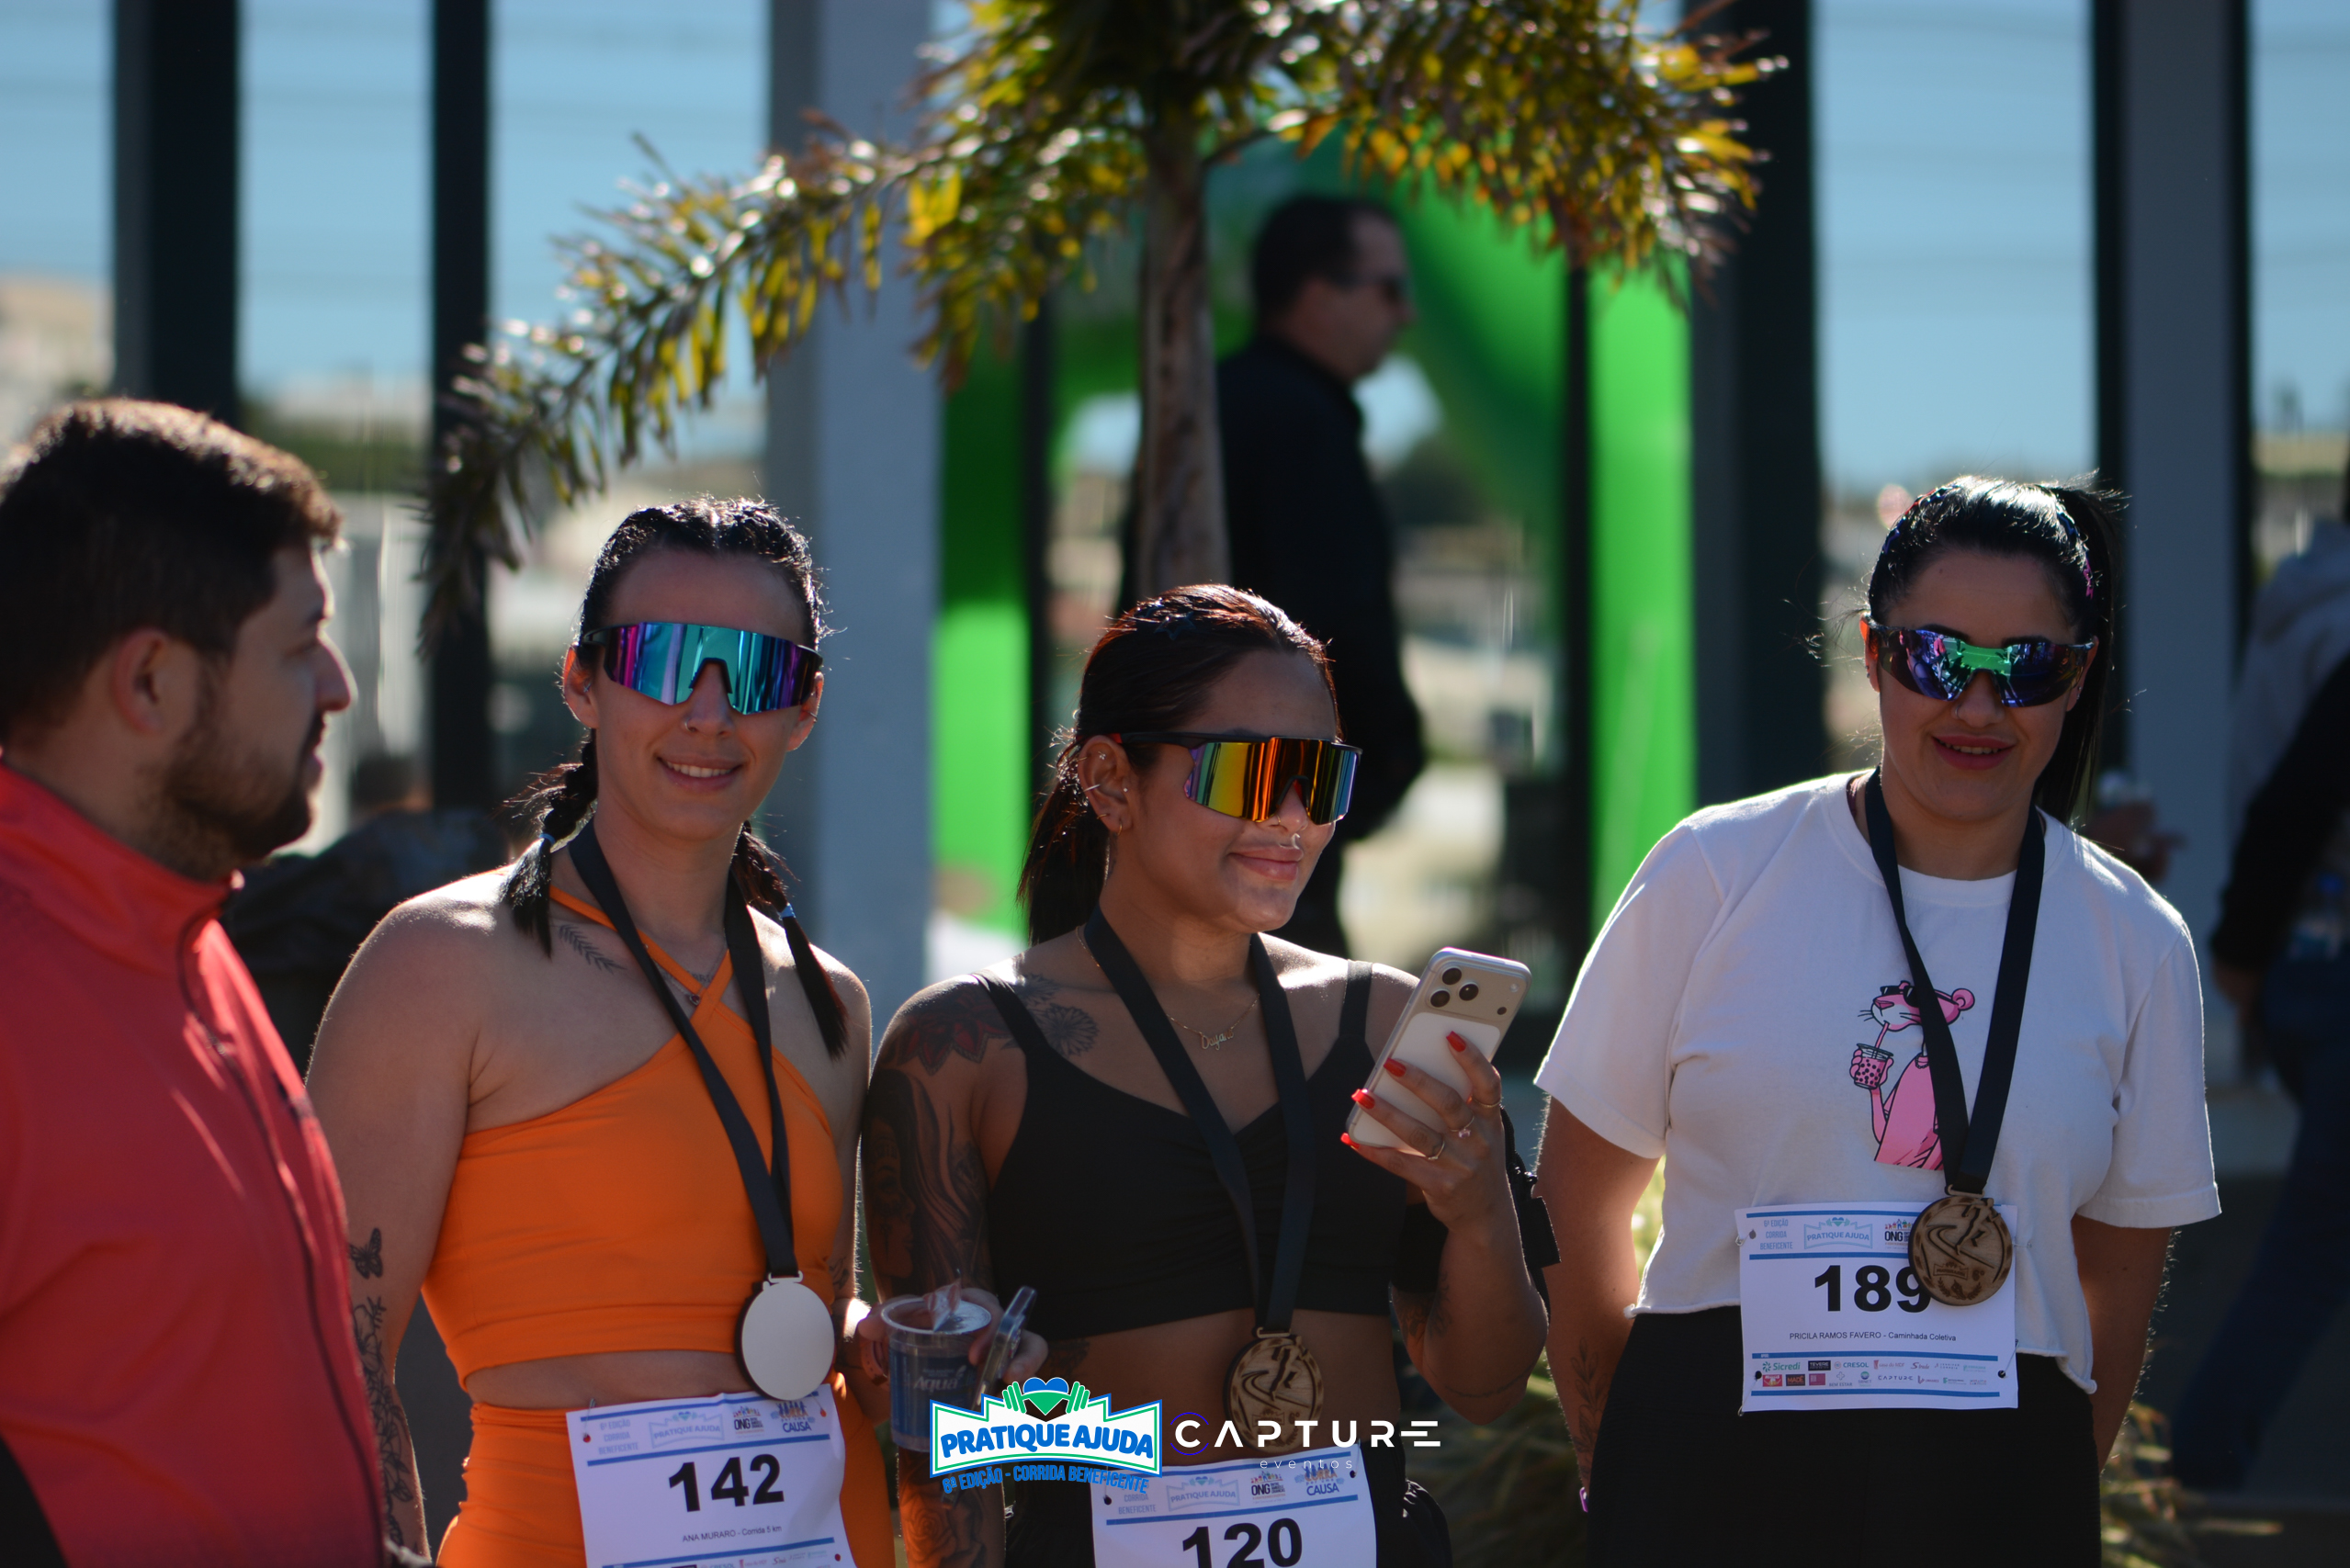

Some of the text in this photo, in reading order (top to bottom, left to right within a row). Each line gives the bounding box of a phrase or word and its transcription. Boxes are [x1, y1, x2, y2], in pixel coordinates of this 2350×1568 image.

[1770, 1218, 1789, 1228] EDIÇÃO
[1765, 1230, 1788, 1239] CORRIDA
[1806, 1231, 1870, 1241] PRATIQUE AJUDA
[1884, 1231, 1904, 1242] ONG
[1759, 1241, 1793, 1250] BENEFICENTE
[1814, 1264, 1932, 1314] 189
[1789, 1332, 1818, 1340] PRICILA
[1818, 1331, 1848, 1339] RAMOS
[1848, 1331, 1882, 1339] FAVERO
[1888, 1332, 1928, 1340] Caminhada
[1928, 1333, 1957, 1342] Coletiva
[1773, 1361, 1801, 1371] Sicredi
[734, 1418, 751, 1431] ONG
[783, 1421, 812, 1433] CAUSA
[604, 1431, 631, 1443] CORRIDA
[653, 1426, 694, 1439] PRATIQUE
[598, 1442, 638, 1455] BENEFICENTE
[668, 1453, 785, 1513] 142
[1251, 1483, 1271, 1496] ONG
[1306, 1483, 1340, 1496] CAUSA
[1170, 1490, 1237, 1503] PRATIQUE AJUDA
[1118, 1505, 1157, 1515] BENEFICENTE
[682, 1533, 701, 1543] ANA
[701, 1529, 737, 1541] MURARO
[741, 1527, 766, 1537] Corrida
[766, 1526, 772, 1534] 5
[772, 1525, 783, 1533] km
[1181, 1517, 1304, 1568] 120
